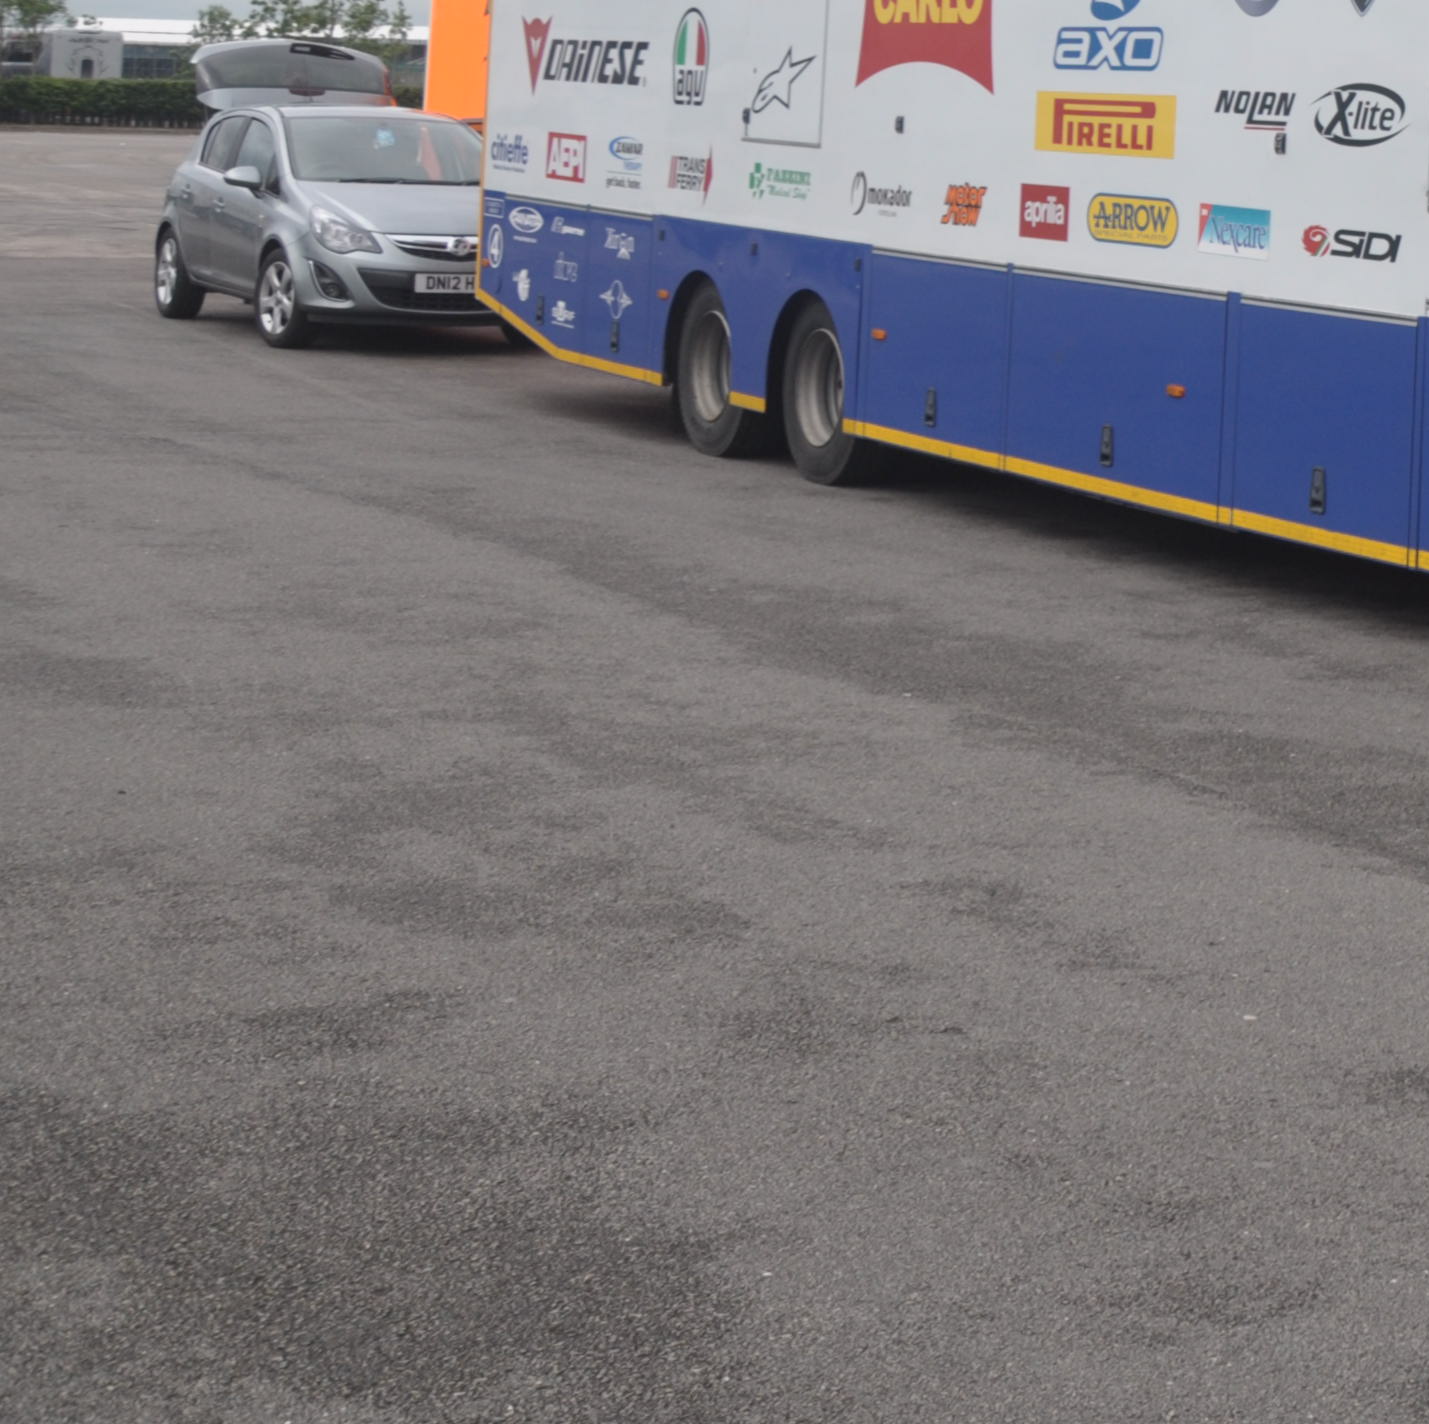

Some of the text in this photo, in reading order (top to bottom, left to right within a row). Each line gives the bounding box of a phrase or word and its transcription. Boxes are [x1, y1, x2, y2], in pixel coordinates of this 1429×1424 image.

[543, 39, 650, 87] DAINESE
[1052, 97, 1156, 151] PIRELLI
[1214, 89, 1296, 126] NOLAN
[1323, 90, 1397, 138] X-lite
[1024, 195, 1066, 228] aprilia
[1093, 202, 1171, 233] ARROW
[1208, 213, 1268, 254] Nexcare
